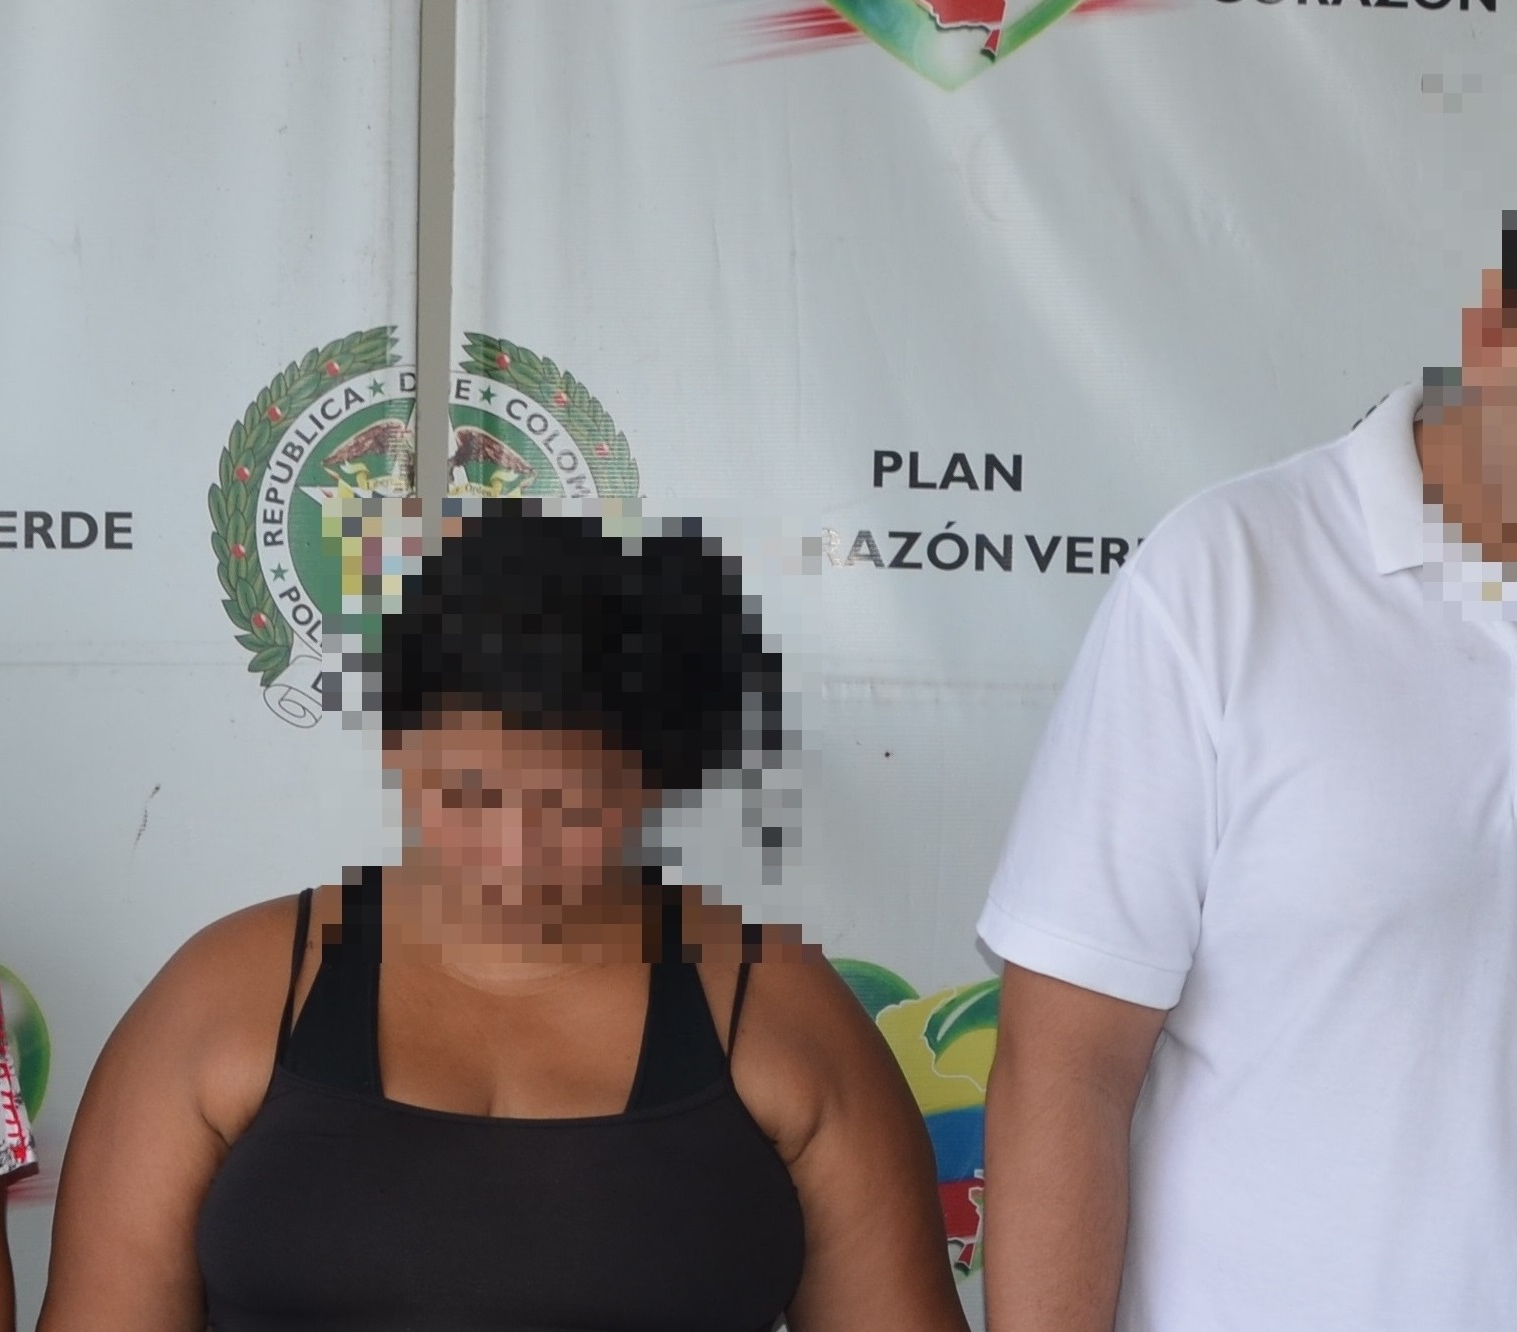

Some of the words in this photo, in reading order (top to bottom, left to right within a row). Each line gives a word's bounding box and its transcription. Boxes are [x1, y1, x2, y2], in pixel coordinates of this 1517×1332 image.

[262, 386, 366, 548] REPÚBLICA
[505, 398, 596, 498] COLOM
[873, 450, 1023, 492] PLAN
[822, 521, 1014, 571] RAZÓN
[1024, 534, 1145, 575] VER
